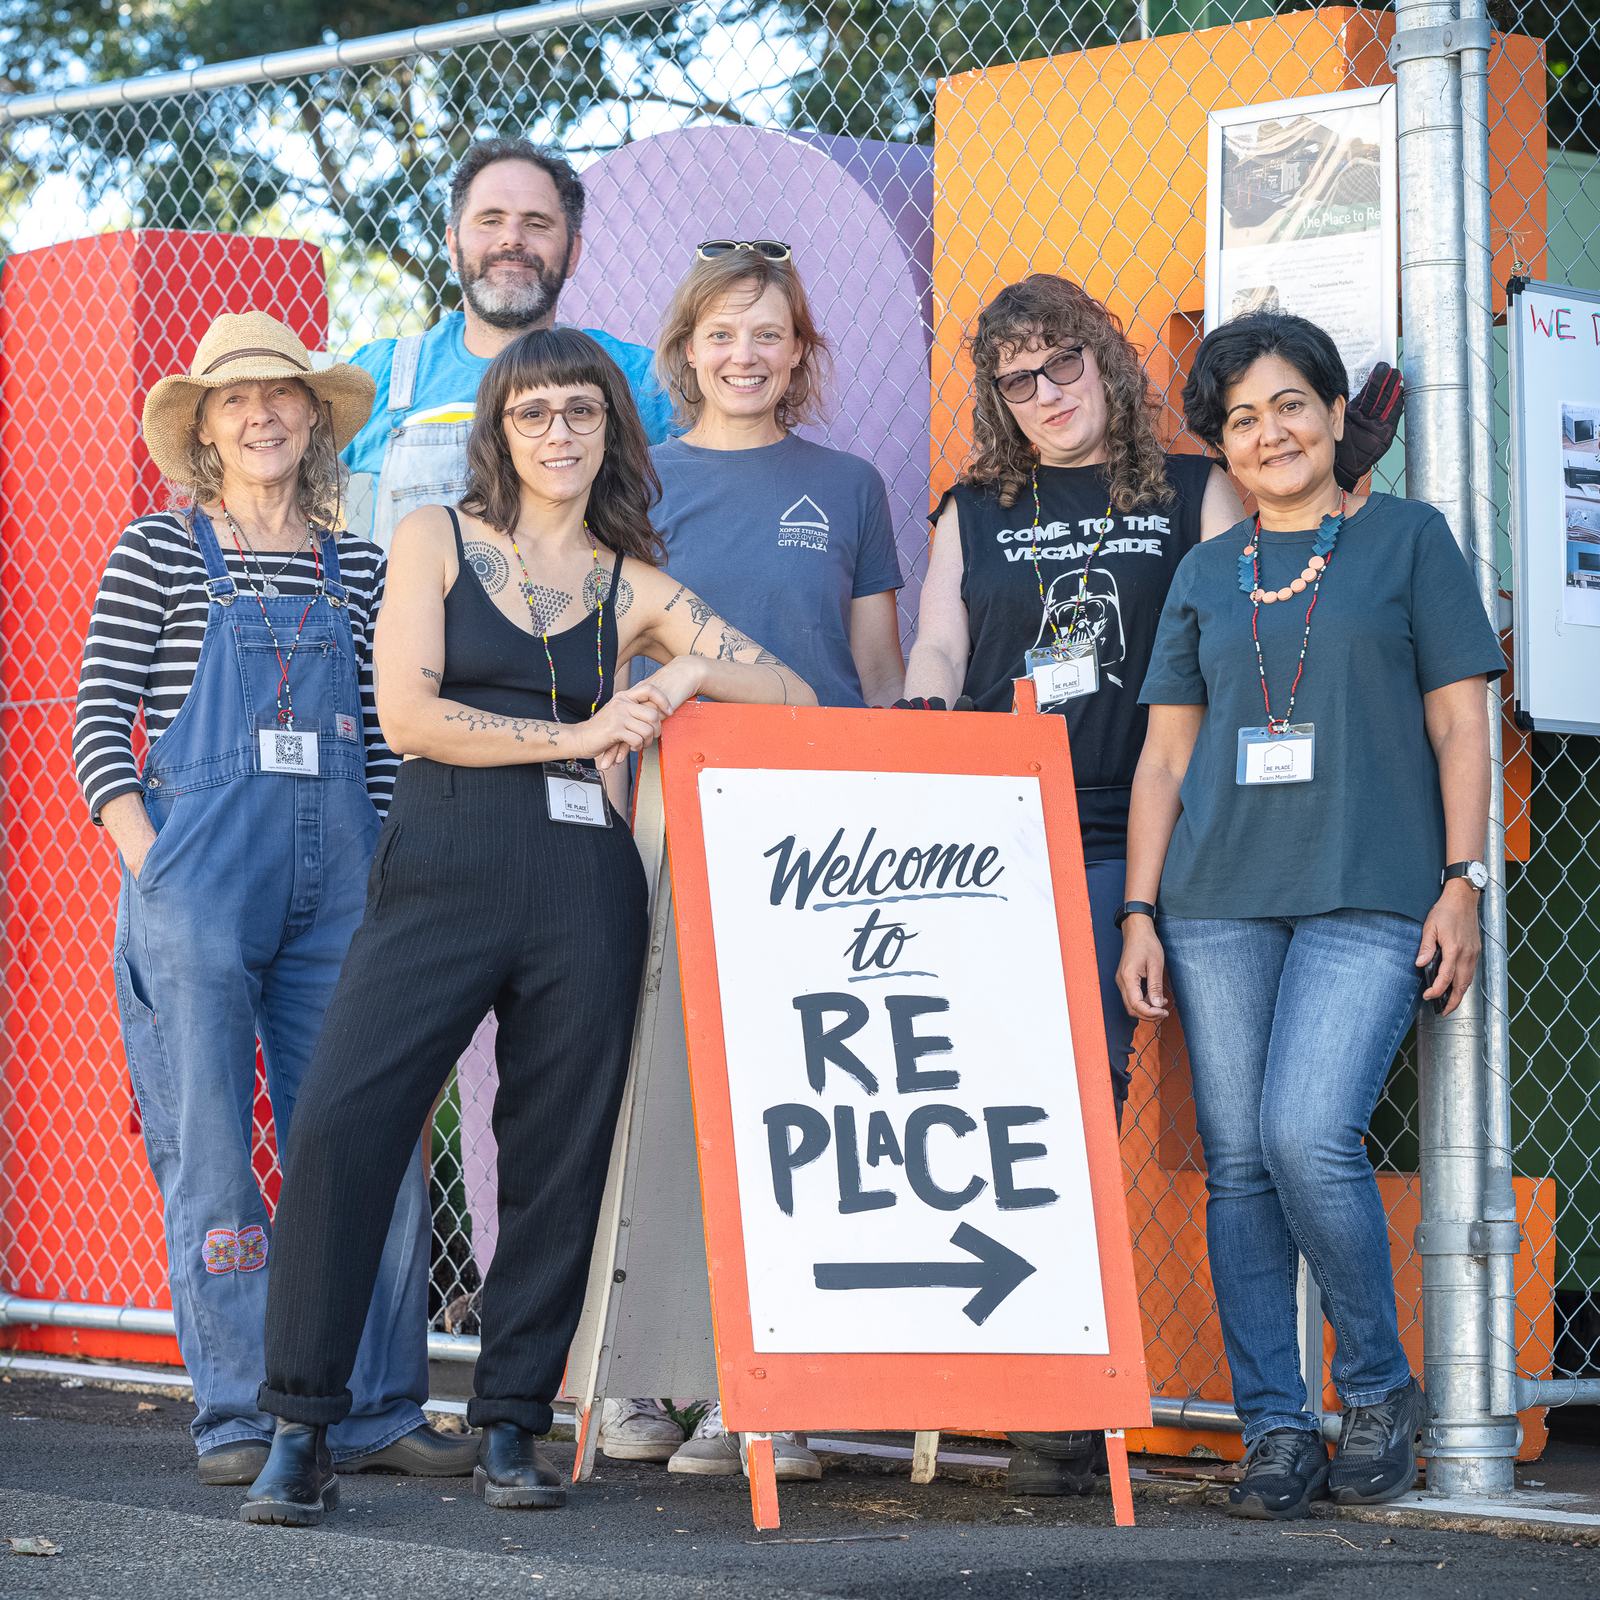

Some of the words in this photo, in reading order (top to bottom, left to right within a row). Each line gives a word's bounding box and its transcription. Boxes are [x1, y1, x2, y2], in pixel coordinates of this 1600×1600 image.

[1322, 210, 1351, 226] Place
[1353, 209, 1364, 223] to
[1530, 304, 1576, 339] WE
[800, 540, 827, 553] PLAZA
[996, 521, 1071, 543] COME
[1078, 517, 1115, 537] TO
[1122, 515, 1171, 535] THE
[1003, 542, 1098, 563] VEGAN
[1098, 537, 1163, 557] SIDE
[763, 827, 1005, 910] Welcome
[843, 908, 921, 971] to
[792, 992, 961, 1096] RE
[763, 1103, 1060, 1217] PLACE
